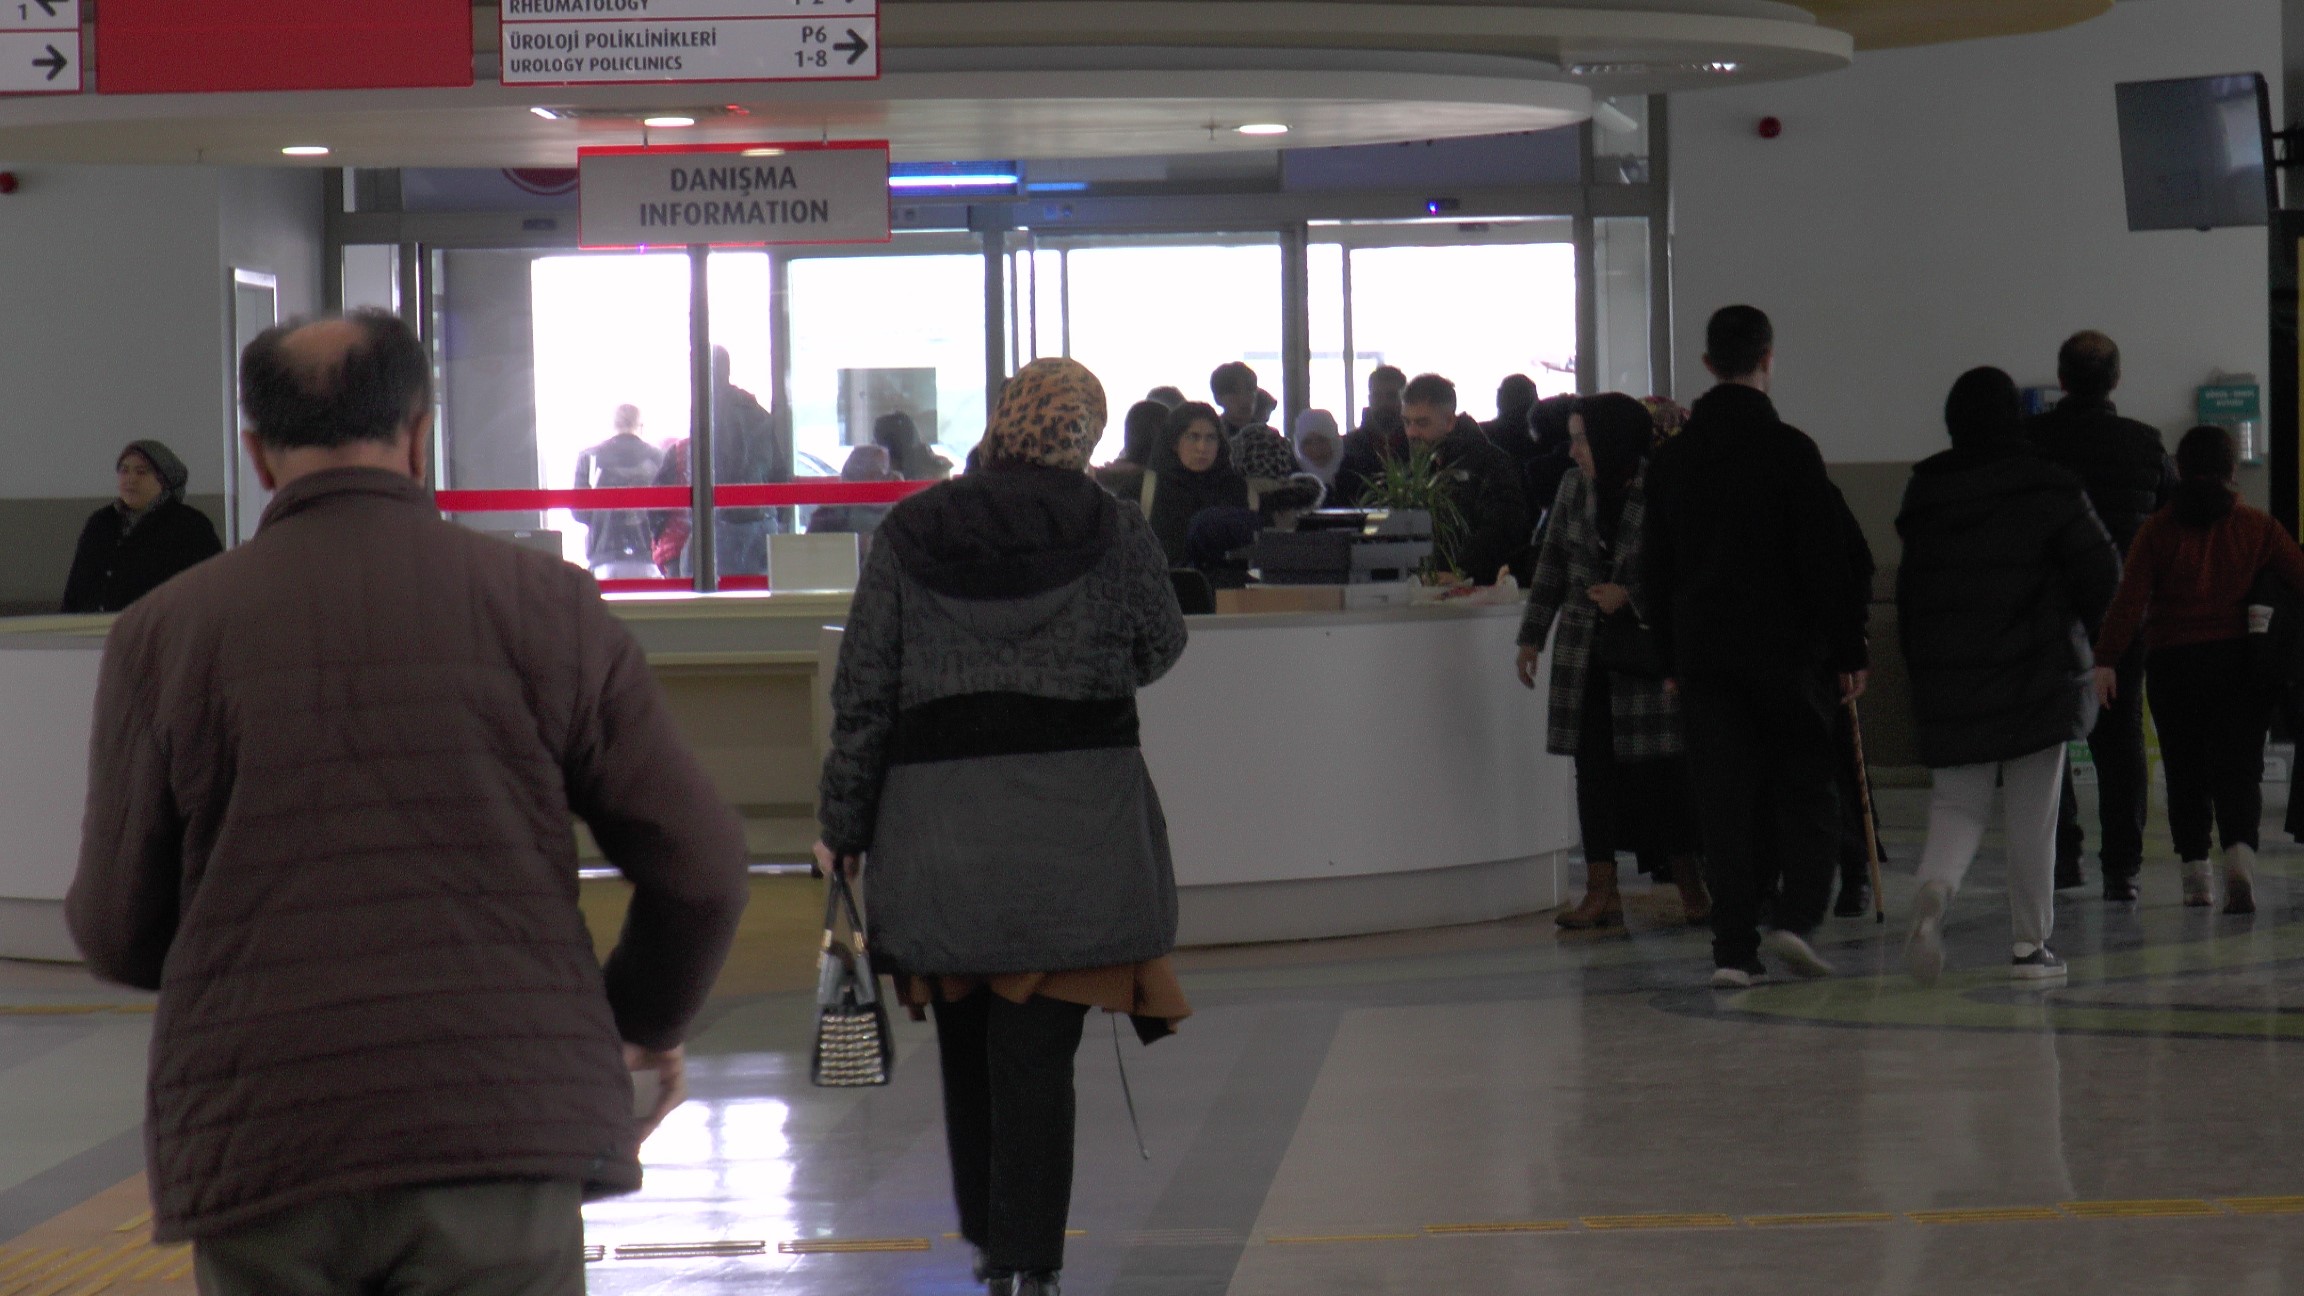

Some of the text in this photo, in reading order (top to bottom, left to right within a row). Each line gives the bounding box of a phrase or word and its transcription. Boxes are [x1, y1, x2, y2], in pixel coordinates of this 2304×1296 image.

[510, 0, 648, 13] RHEUMATOLOGY
[510, 25, 827, 53] ÜROLOJİ POLİKLİNİKLERİ P6
[510, 49, 827, 73] UROLOGY POLICLINICS 1-8
[670, 166, 798, 196] DANIŞMA
[640, 199, 829, 227] INFORMATION
